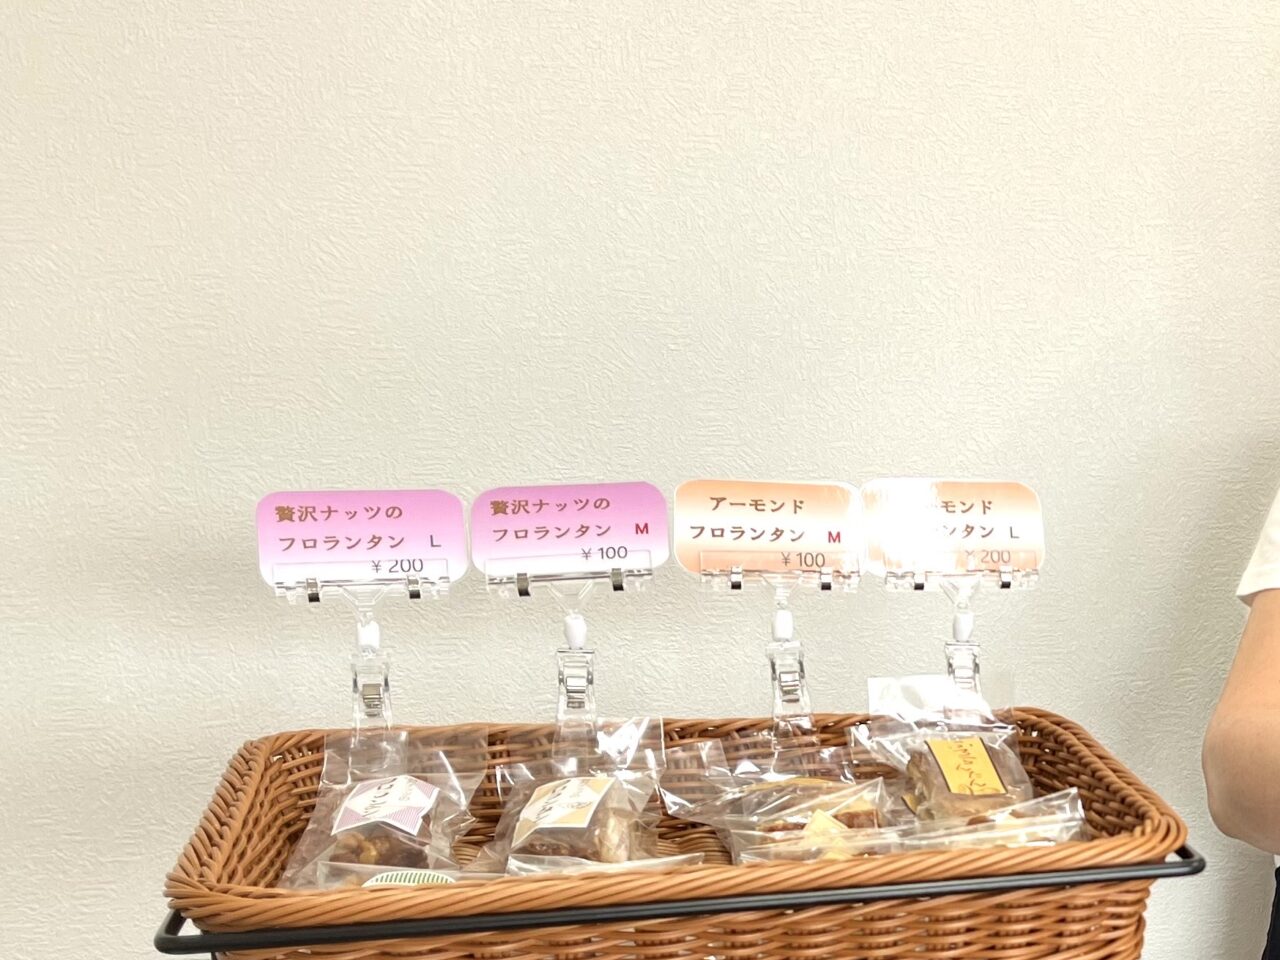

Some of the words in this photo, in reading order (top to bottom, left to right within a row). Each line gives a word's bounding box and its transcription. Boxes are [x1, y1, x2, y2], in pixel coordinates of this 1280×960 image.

[275, 505, 403, 522] 贅沢ナッツの
[490, 497, 612, 516] 贅沢ナッツの
[710, 496, 805, 514] アーモンド
[938, 499, 993, 515] モンド
[492, 523, 612, 542] フロランタン
[635, 522, 649, 535] M
[689, 524, 804, 543] フロランタン
[828, 532, 841, 543] M
[1010, 526, 1020, 539] L
[278, 534, 406, 552] フロランタン
[430, 535, 441, 548] L
[581, 546, 628, 561] ¥100
[781, 552, 826, 568] ¥100
